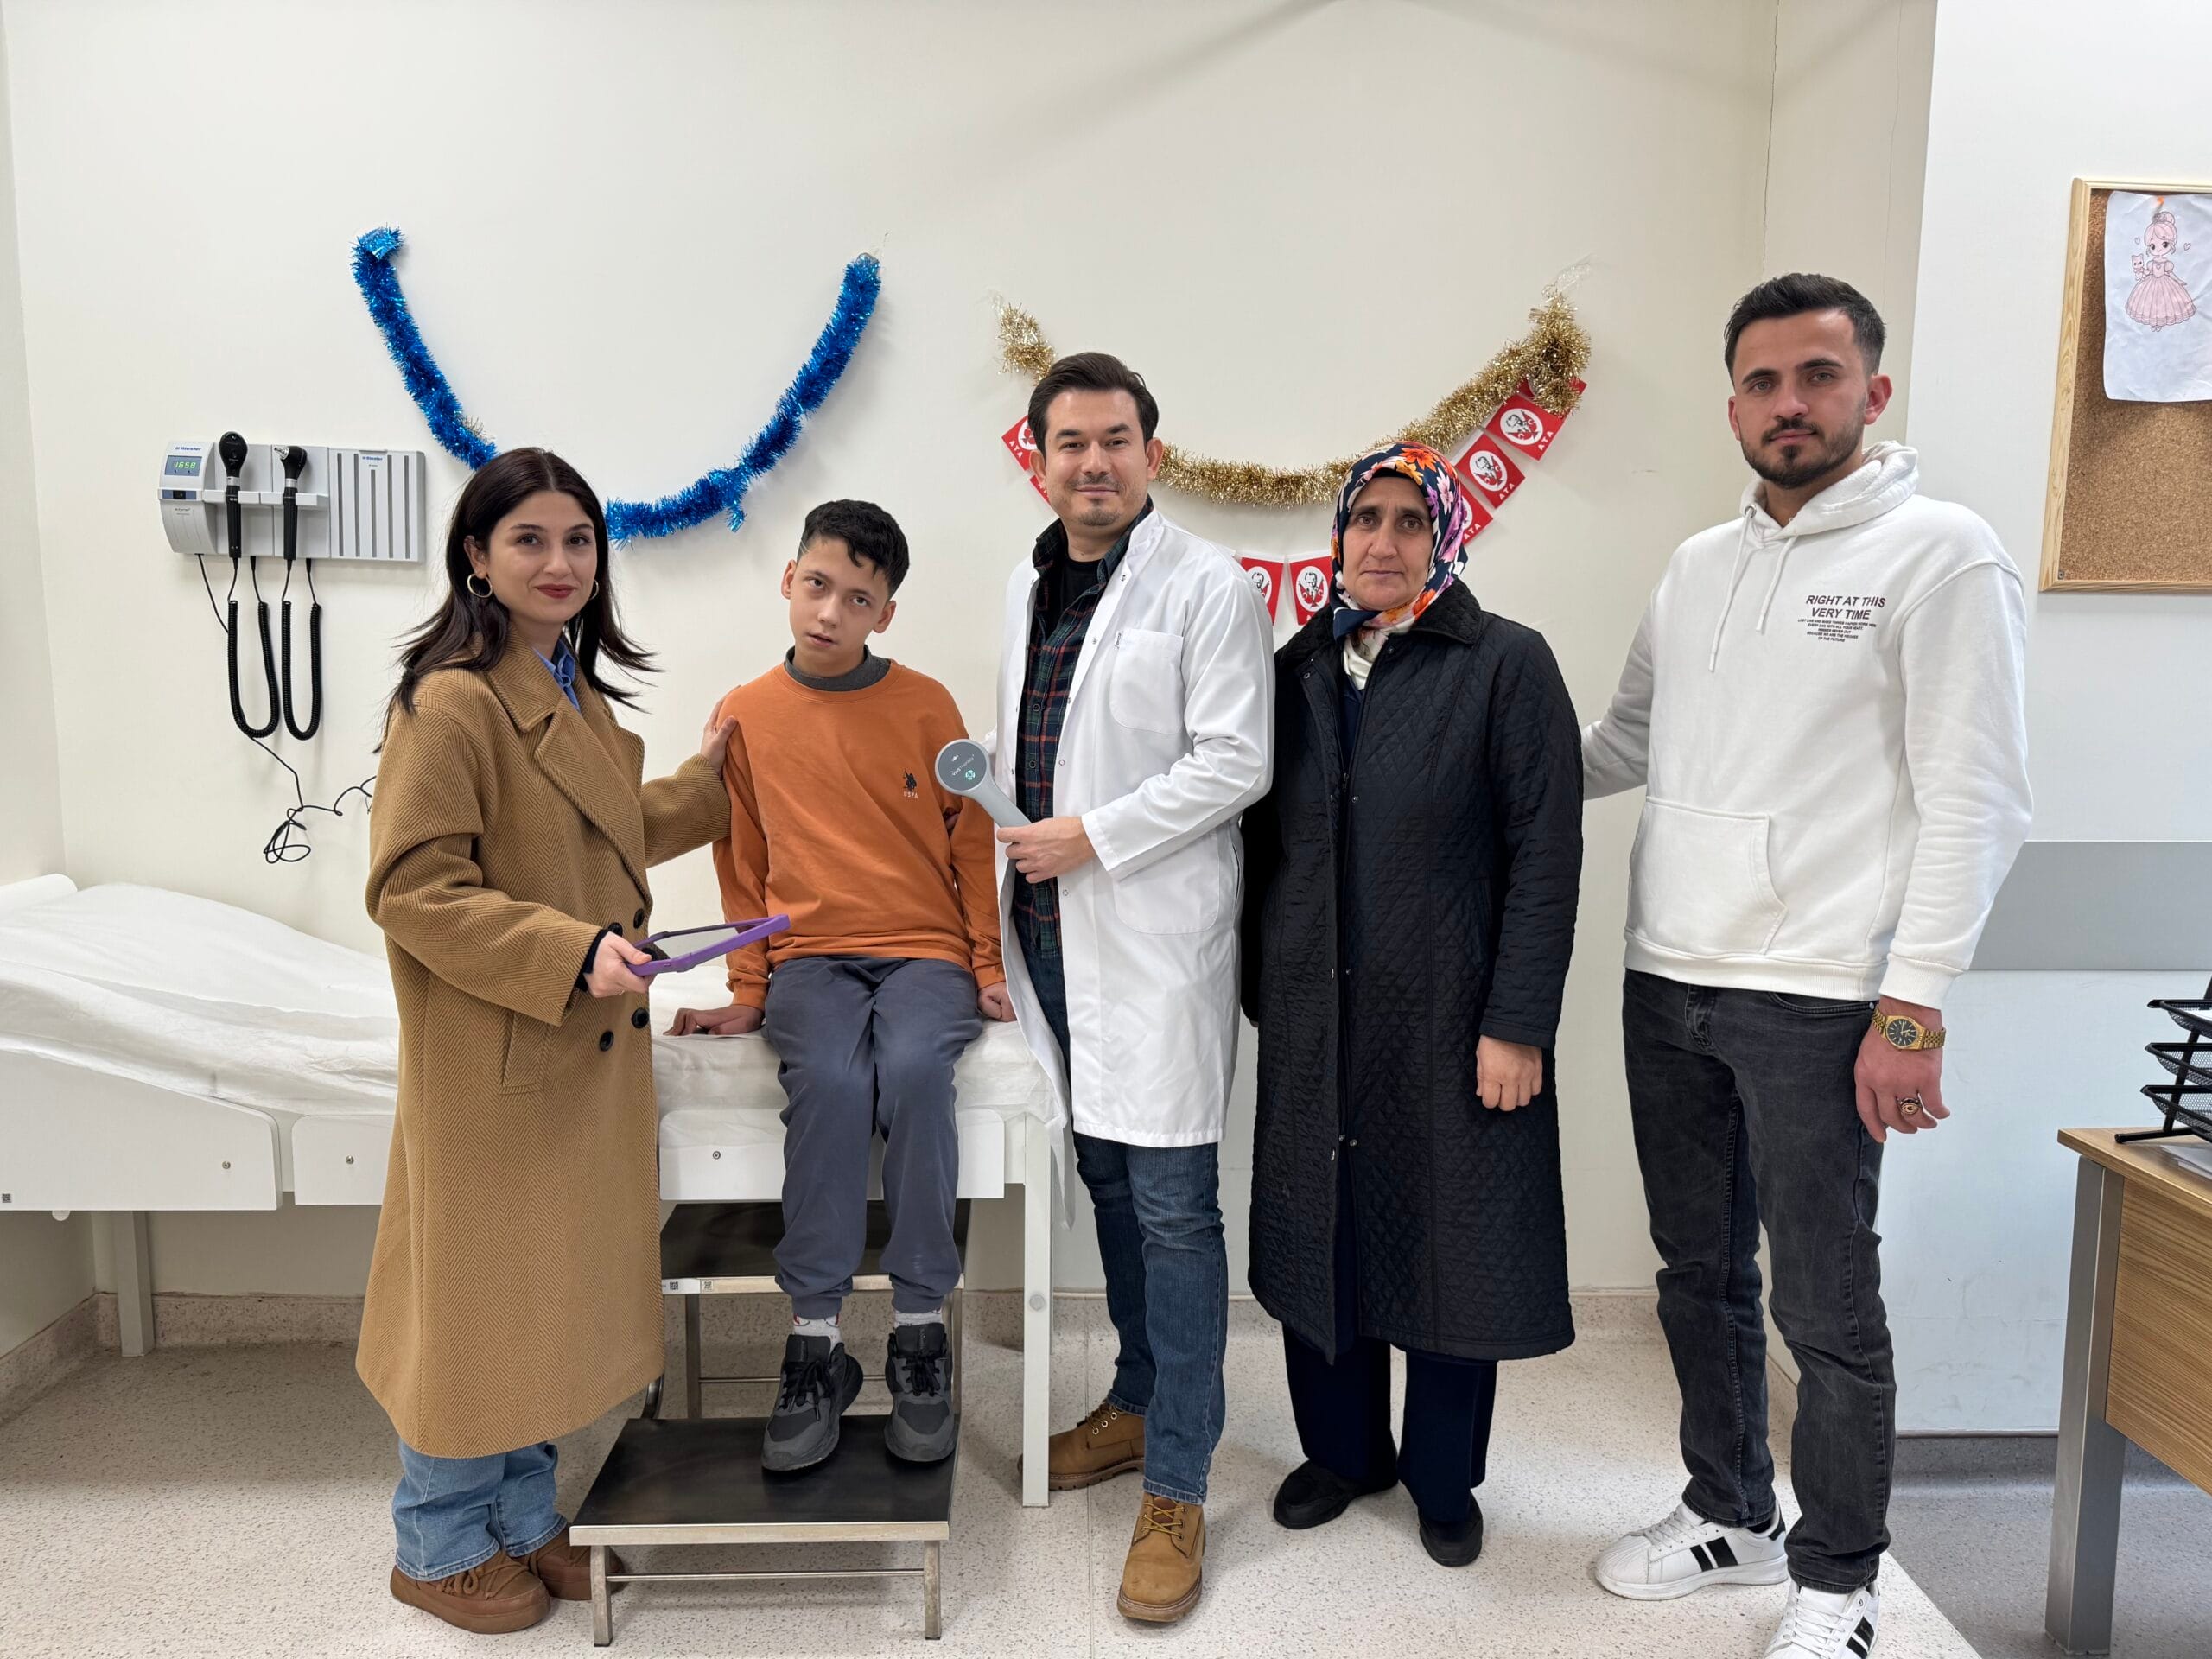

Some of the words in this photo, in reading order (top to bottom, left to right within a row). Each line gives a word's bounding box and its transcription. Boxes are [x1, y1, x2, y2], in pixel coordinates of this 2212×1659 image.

[1009, 440, 1023, 458] ATA
[1537, 430, 1554, 451] ATA
[1499, 483, 1515, 500] ATA
[1464, 523, 1481, 540] ATA
[1806, 595, 1842, 606] RIGHT
[1842, 596, 1859, 607] AT
[1862, 596, 1886, 608] THIS
[1812, 607, 1842, 618] VERY
[1845, 609, 1872, 620] TIME
